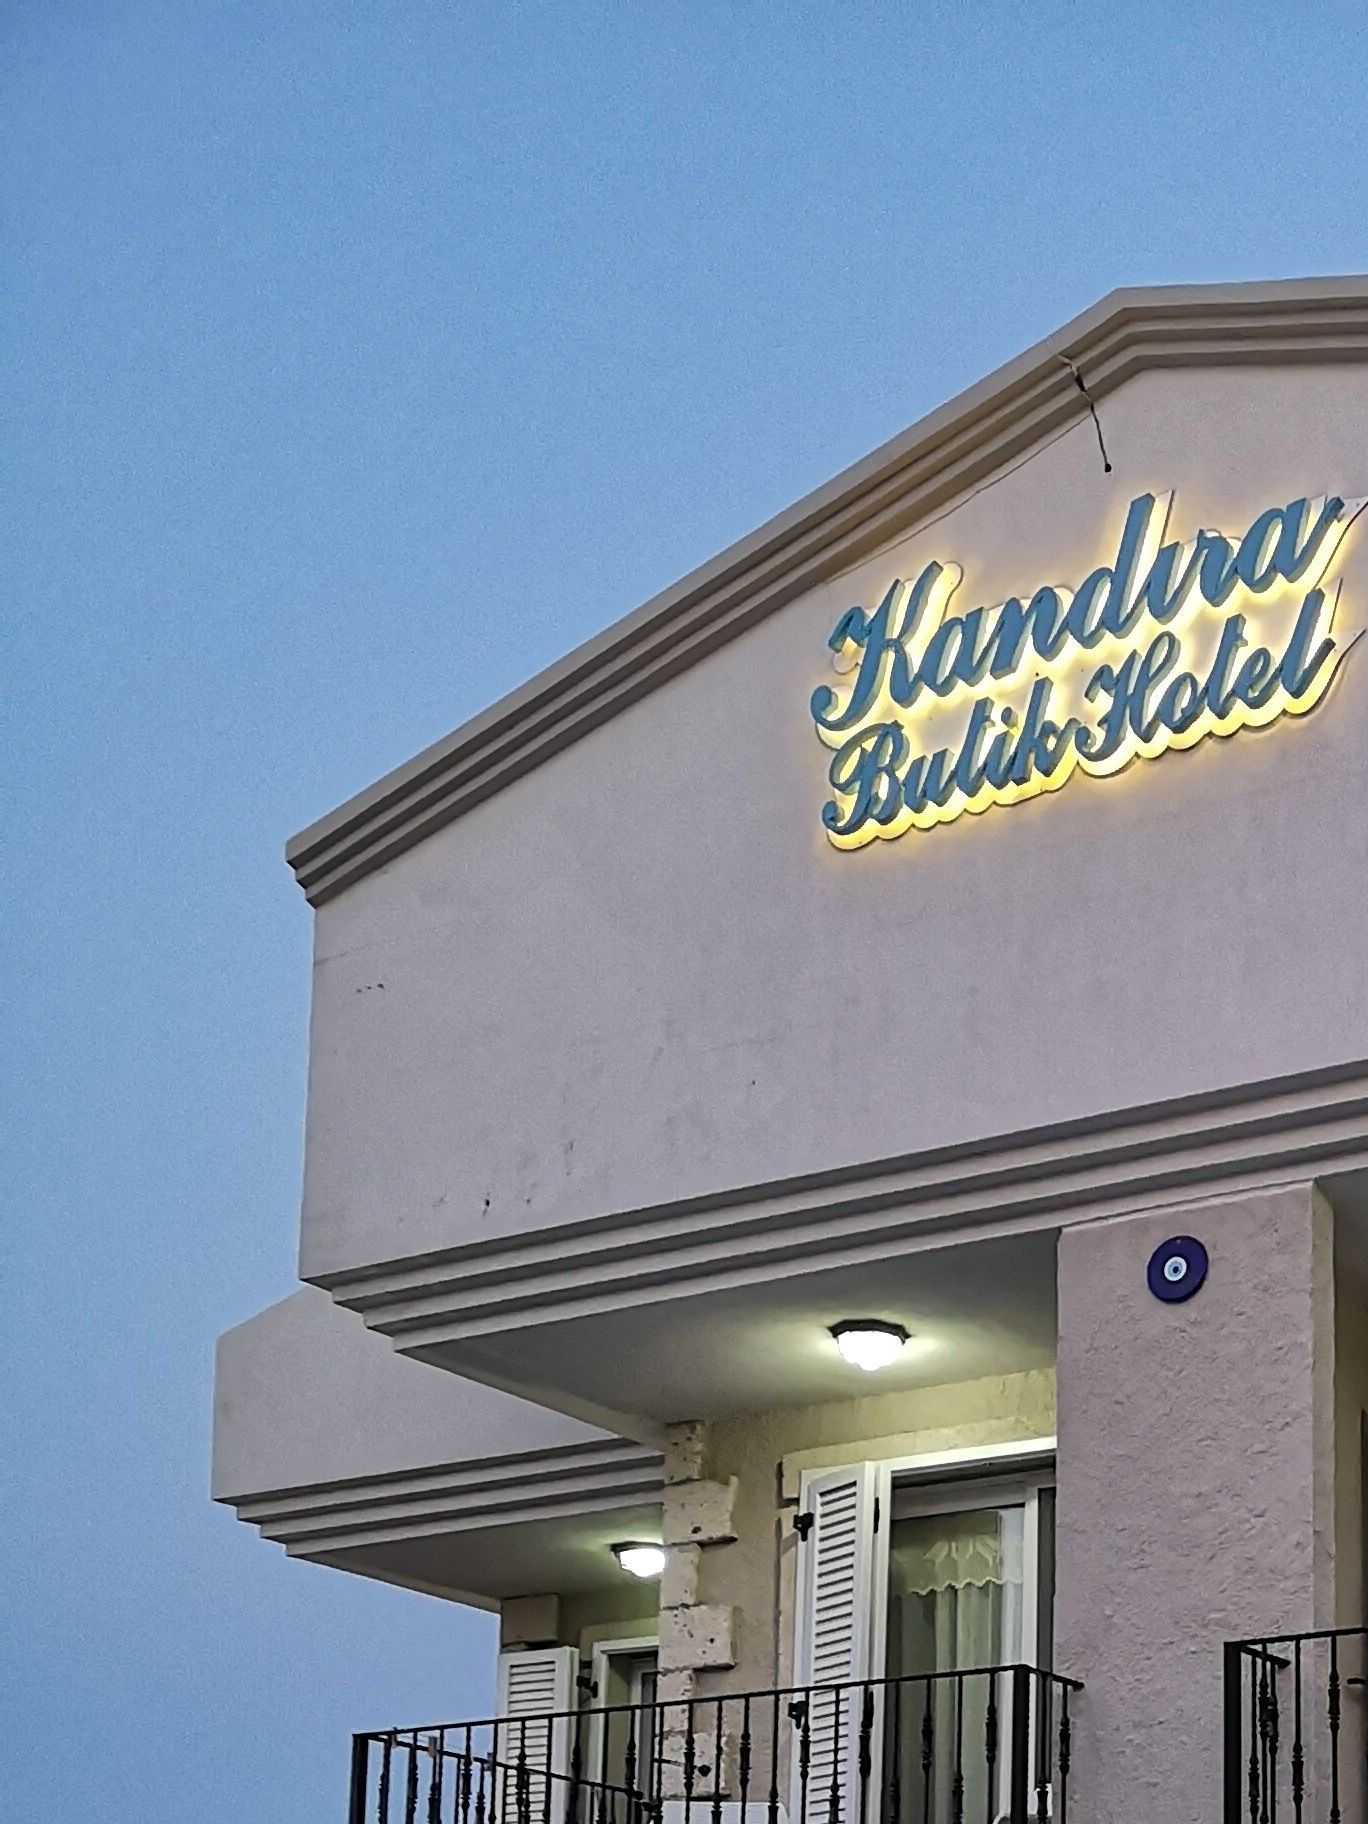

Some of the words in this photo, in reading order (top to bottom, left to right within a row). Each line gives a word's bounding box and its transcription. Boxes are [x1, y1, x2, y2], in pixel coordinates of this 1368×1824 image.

[810, 492, 1347, 731] Kandıra
[822, 676, 1076, 836] Butik
[1074, 587, 1336, 762] Hotel
